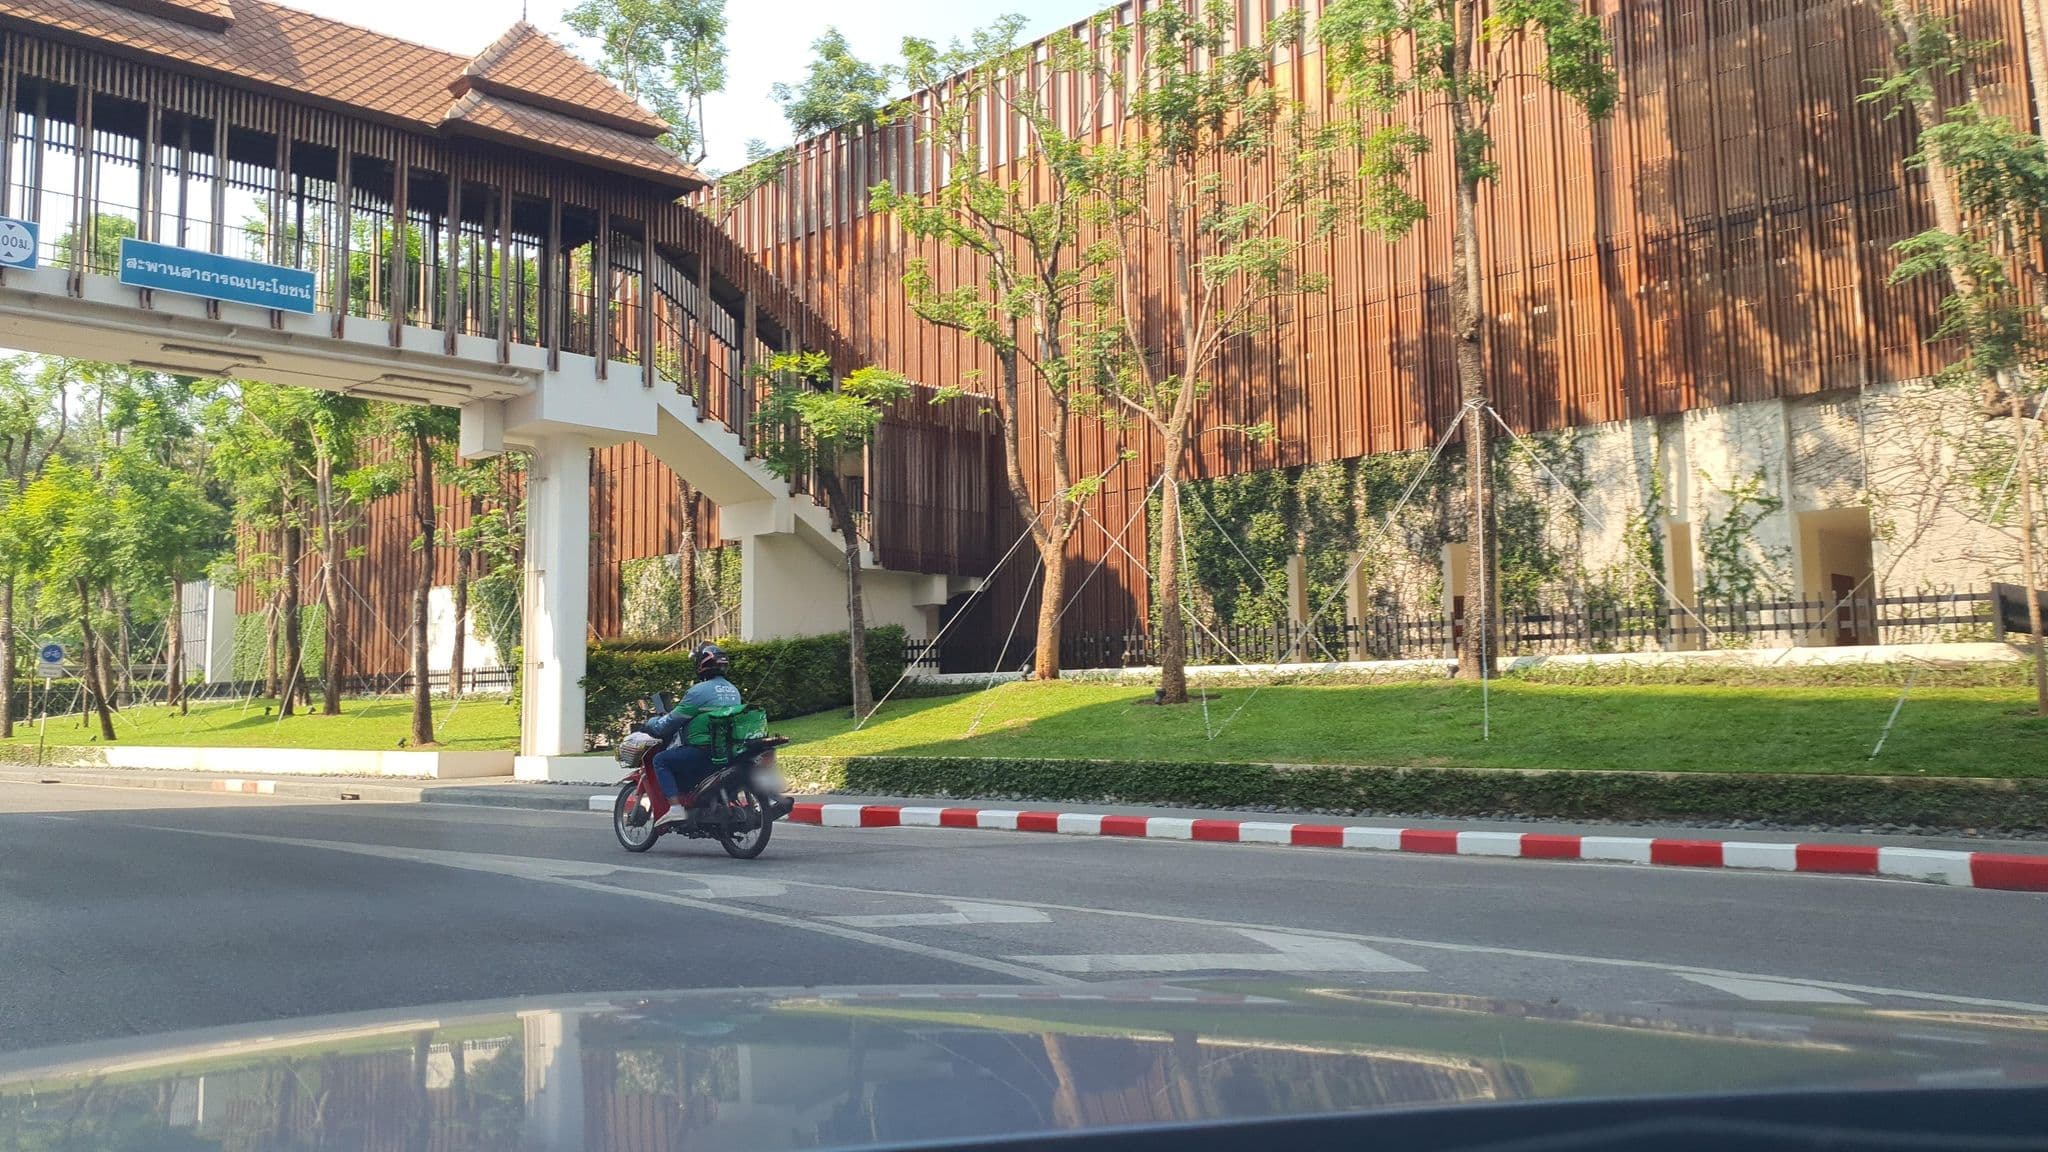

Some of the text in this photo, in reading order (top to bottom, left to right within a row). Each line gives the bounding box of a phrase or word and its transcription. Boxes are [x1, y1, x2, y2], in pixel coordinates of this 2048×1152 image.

[126, 258, 311, 299] สะพานสาธารณประโยชน์
